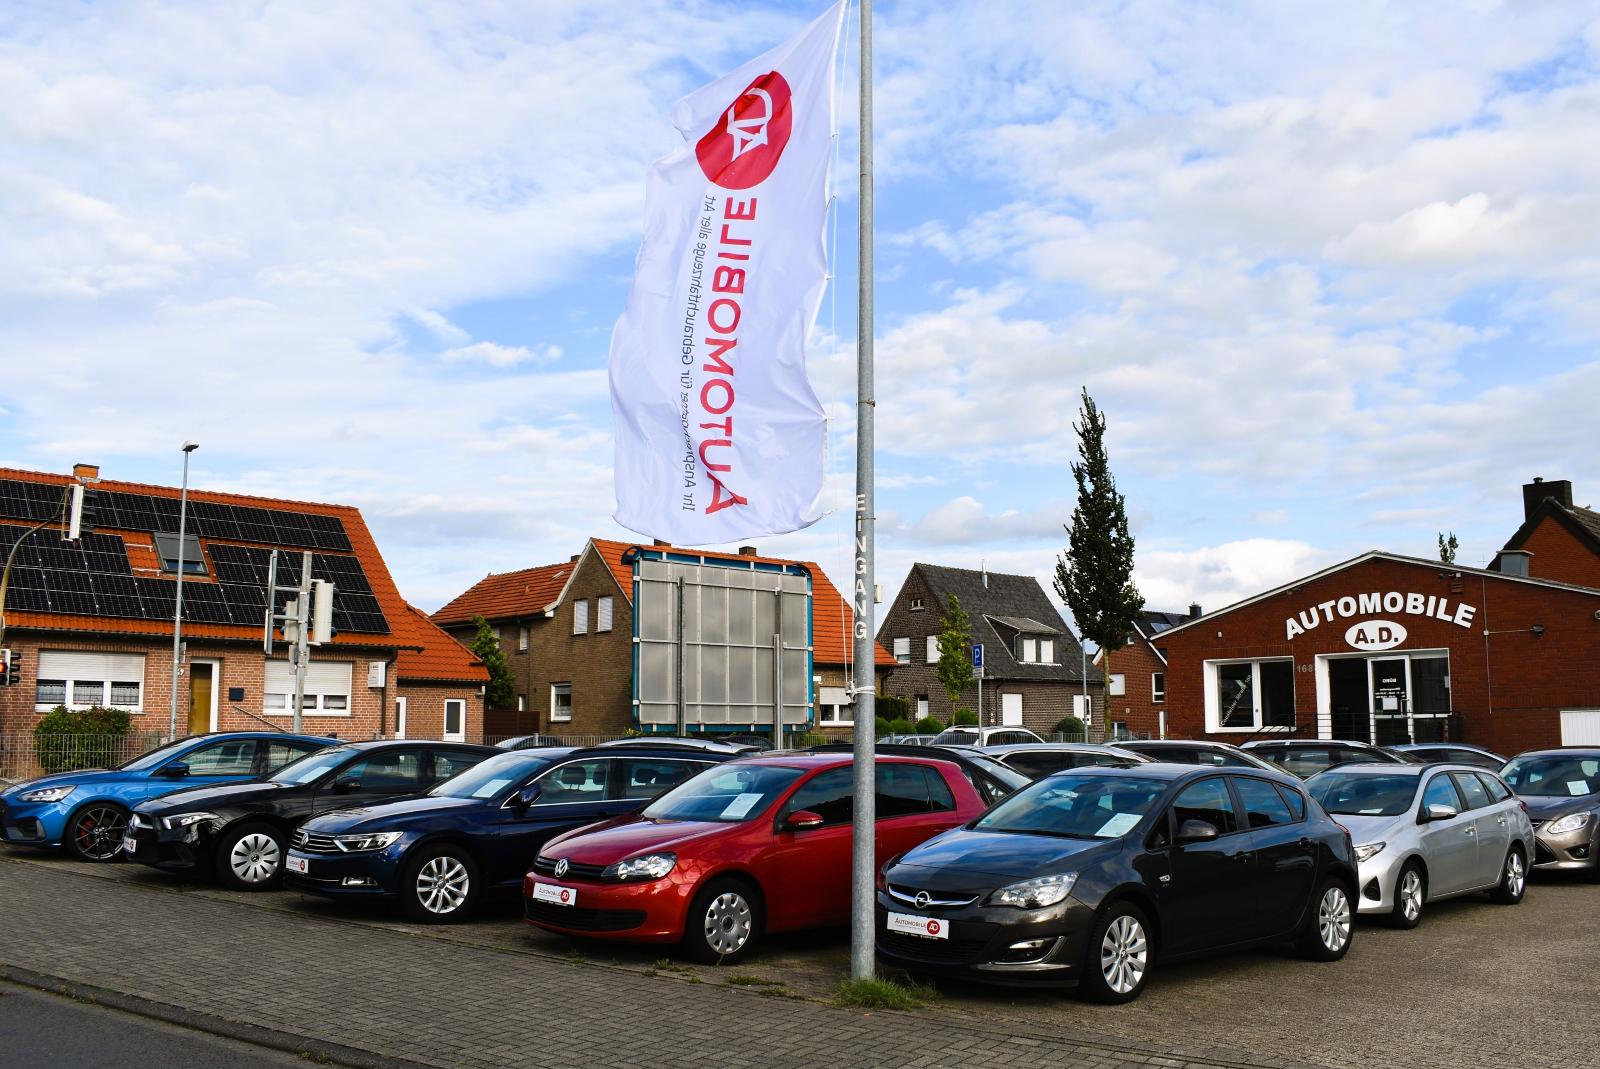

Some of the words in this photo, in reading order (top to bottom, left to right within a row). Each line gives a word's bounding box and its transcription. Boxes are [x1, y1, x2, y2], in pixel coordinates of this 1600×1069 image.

[854, 494, 867, 639] EINGANG
[1286, 591, 1477, 641] AUTOMOBILE
[1354, 627, 1399, 645] A.D.
[1296, 664, 1314, 673] 168
